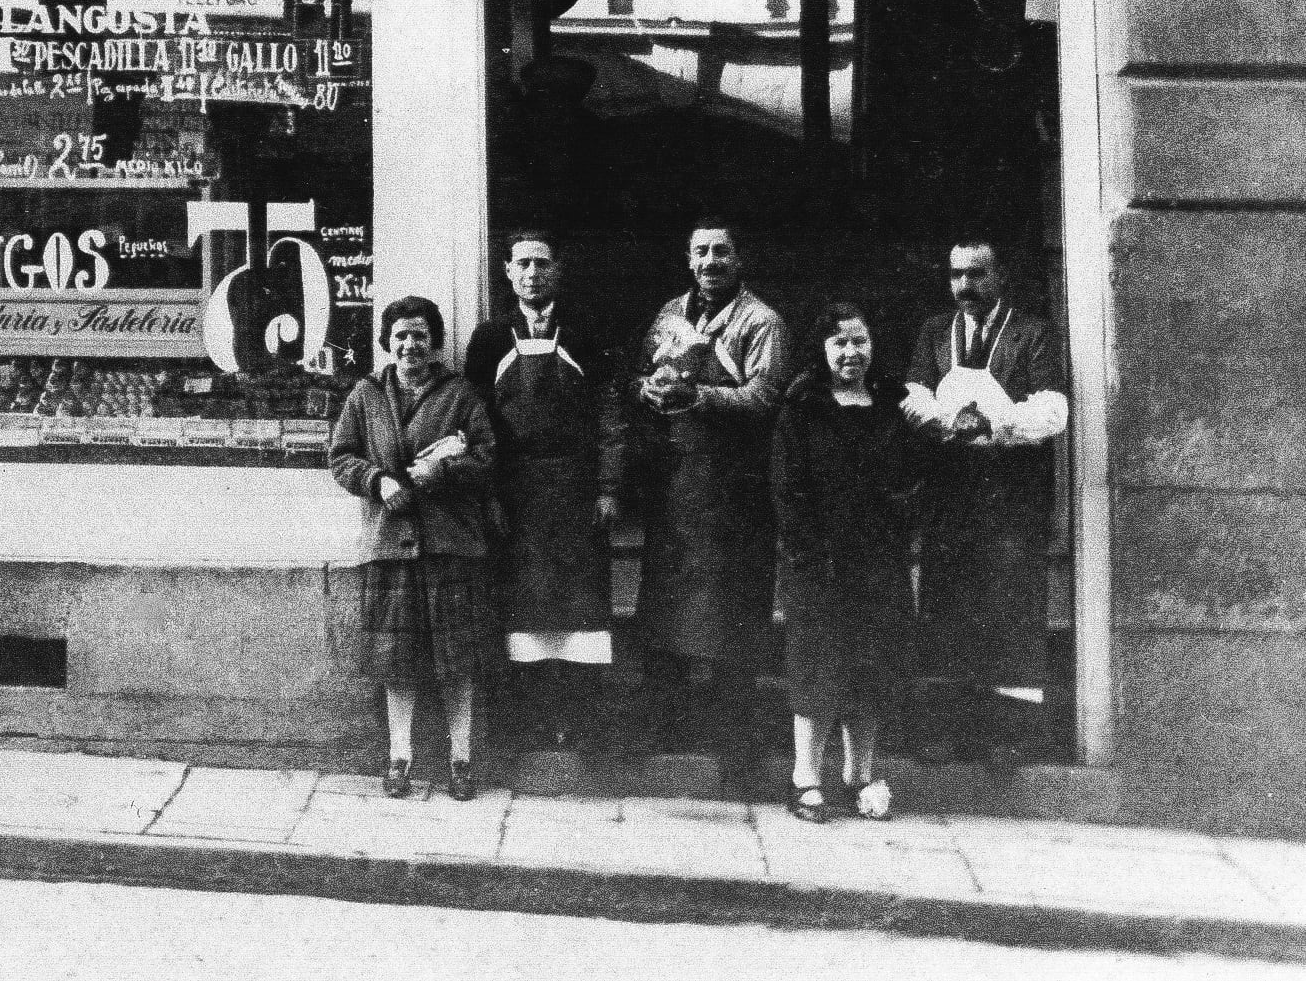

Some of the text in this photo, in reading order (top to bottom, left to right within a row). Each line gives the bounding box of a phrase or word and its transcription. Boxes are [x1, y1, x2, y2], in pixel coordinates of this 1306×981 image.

[0, 5, 211, 34] LANGOSTA
[35, 39, 171, 71] PESCADILLA
[226, 42, 298, 73] GALLO
